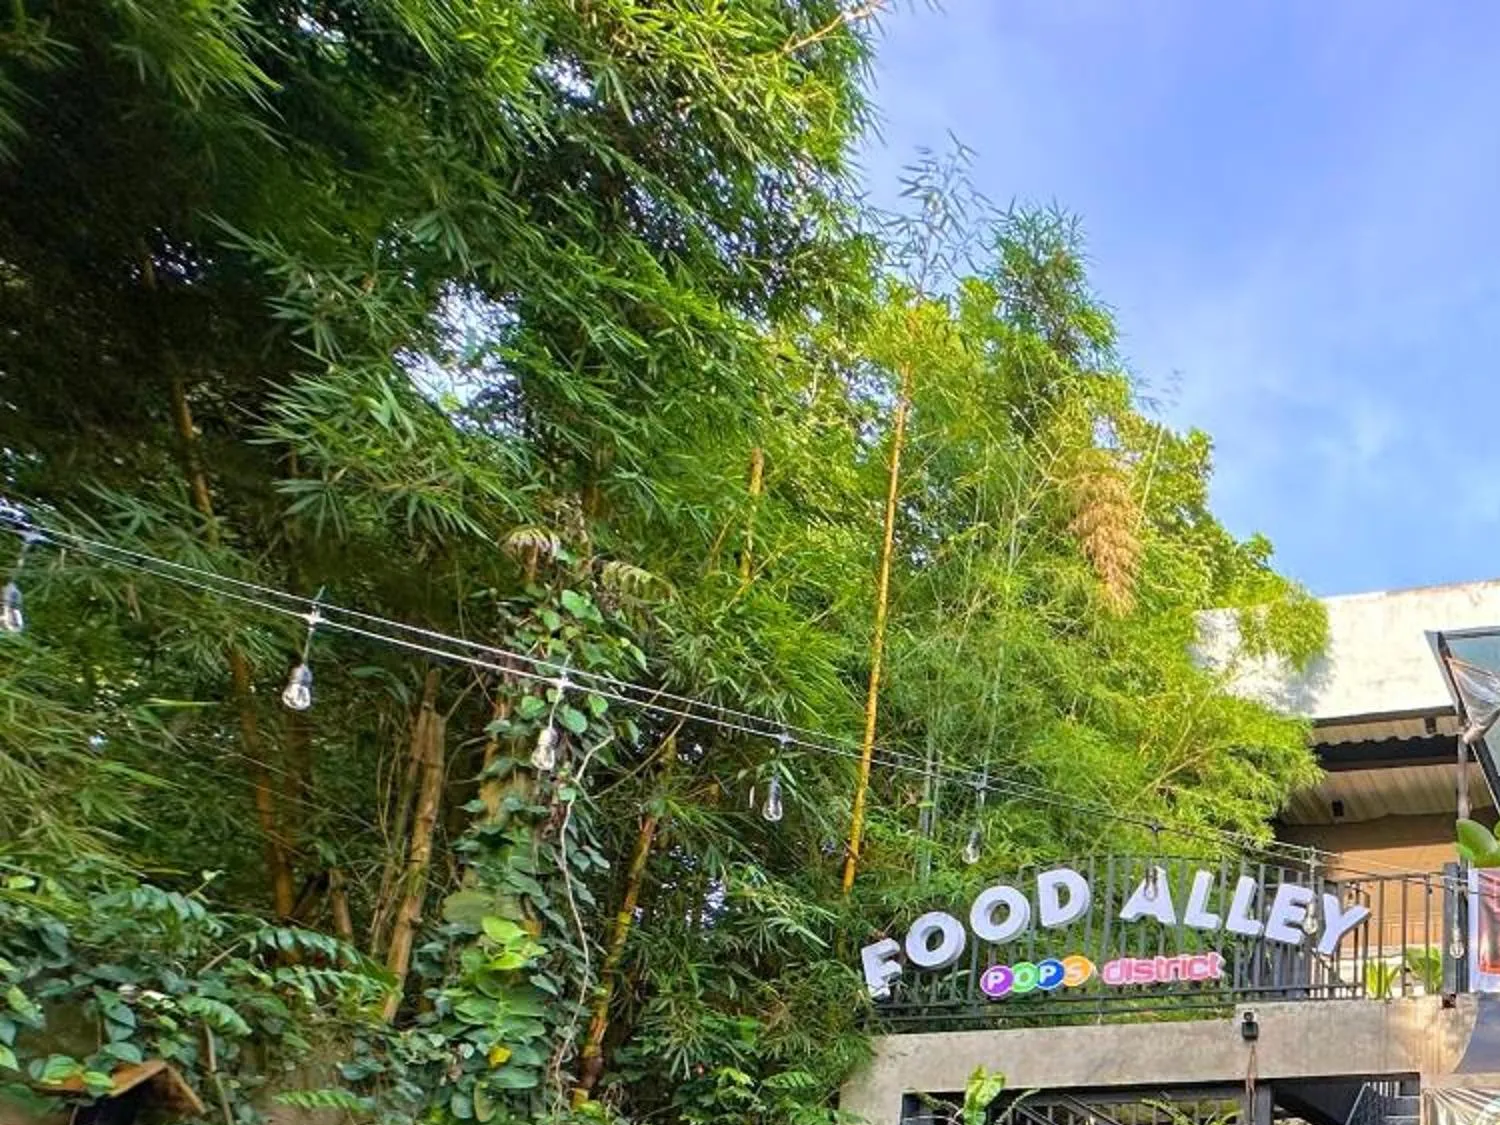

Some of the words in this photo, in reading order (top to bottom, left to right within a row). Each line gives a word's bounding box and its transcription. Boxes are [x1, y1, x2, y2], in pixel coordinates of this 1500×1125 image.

[860, 867, 1095, 998] FOOD
[1120, 865, 1371, 956] ALLEY
[983, 957, 1092, 995] POPS
[1103, 952, 1223, 985] district
